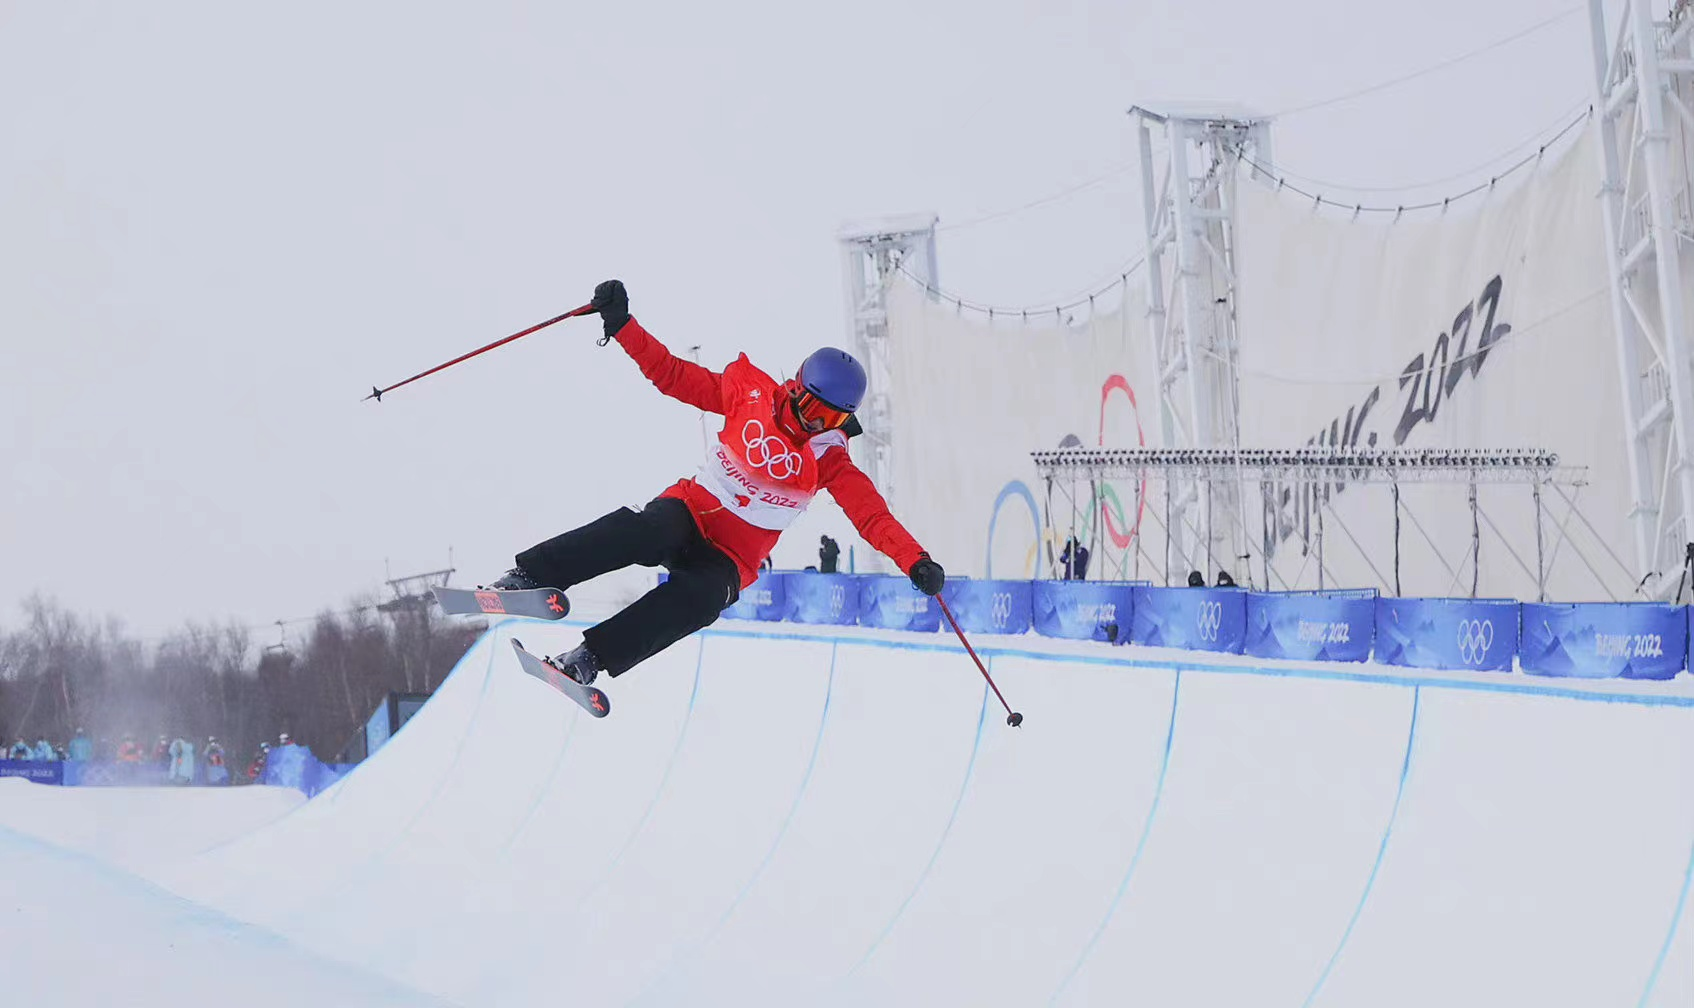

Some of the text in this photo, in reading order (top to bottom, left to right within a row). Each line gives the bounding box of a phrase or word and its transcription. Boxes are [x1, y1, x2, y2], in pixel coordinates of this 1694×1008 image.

[1393, 274, 1512, 447] 2022
[716, 451, 798, 508] BEIJING 2022
[1328, 622, 1350, 644] 2022
[1595, 634, 1663, 660] BEIJING 2022
